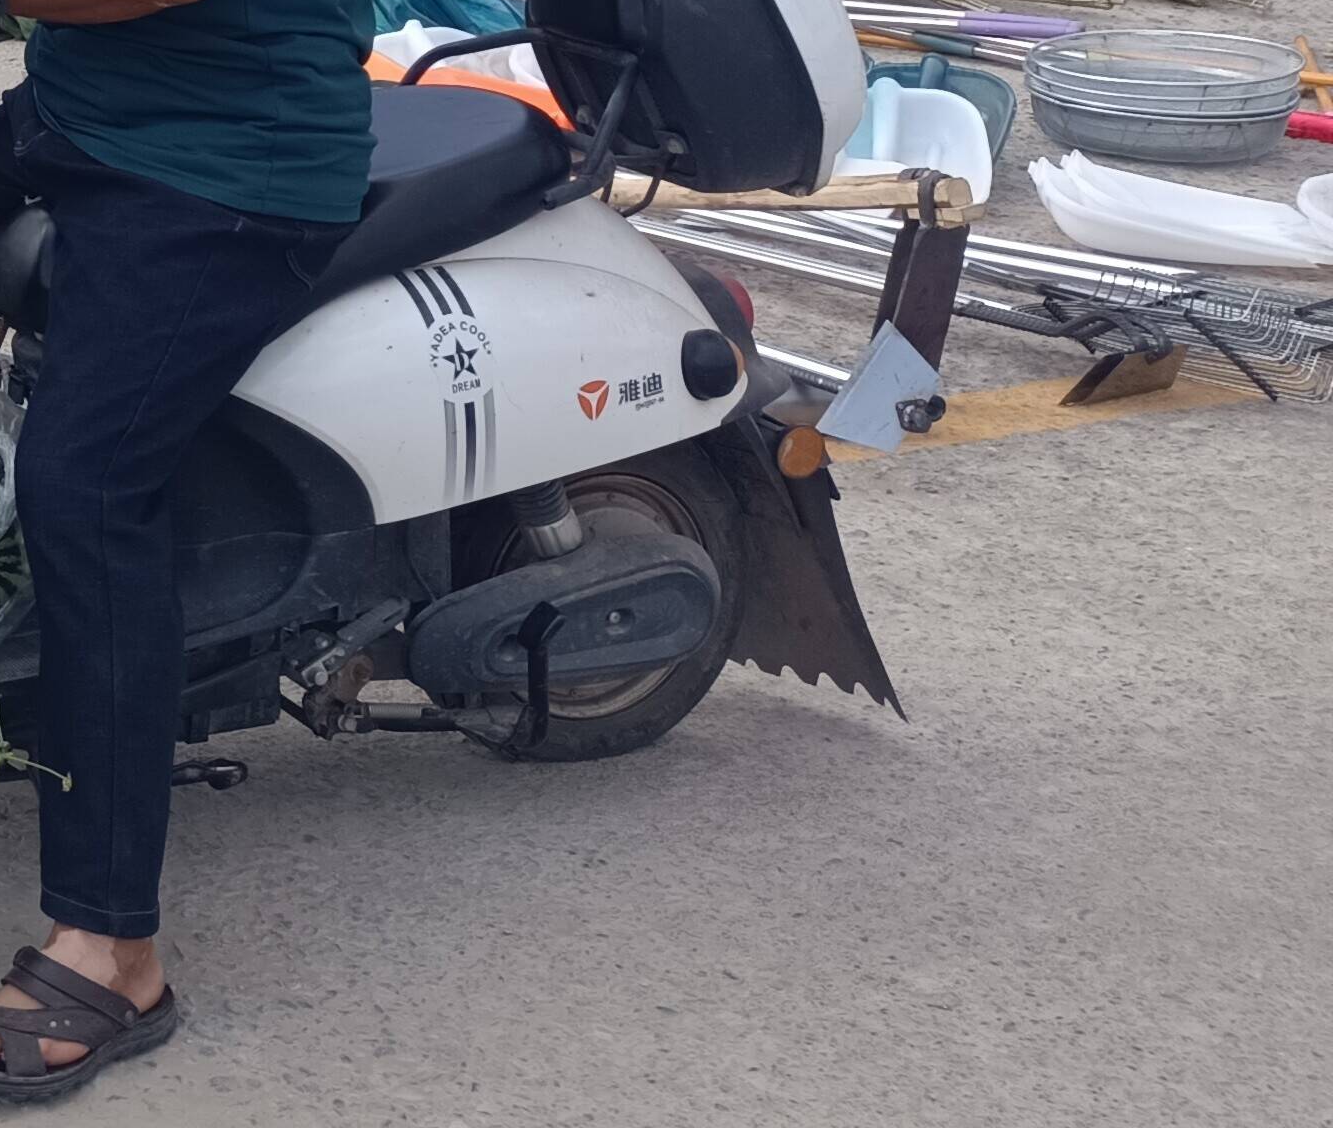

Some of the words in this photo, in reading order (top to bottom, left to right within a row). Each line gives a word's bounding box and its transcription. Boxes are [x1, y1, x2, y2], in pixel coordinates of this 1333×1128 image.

[429, 322, 457, 363] YADEA
[459, 320, 490, 350] COOL
[452, 378, 481, 394] DREAM
[618, 372, 663, 405] 雅迪
